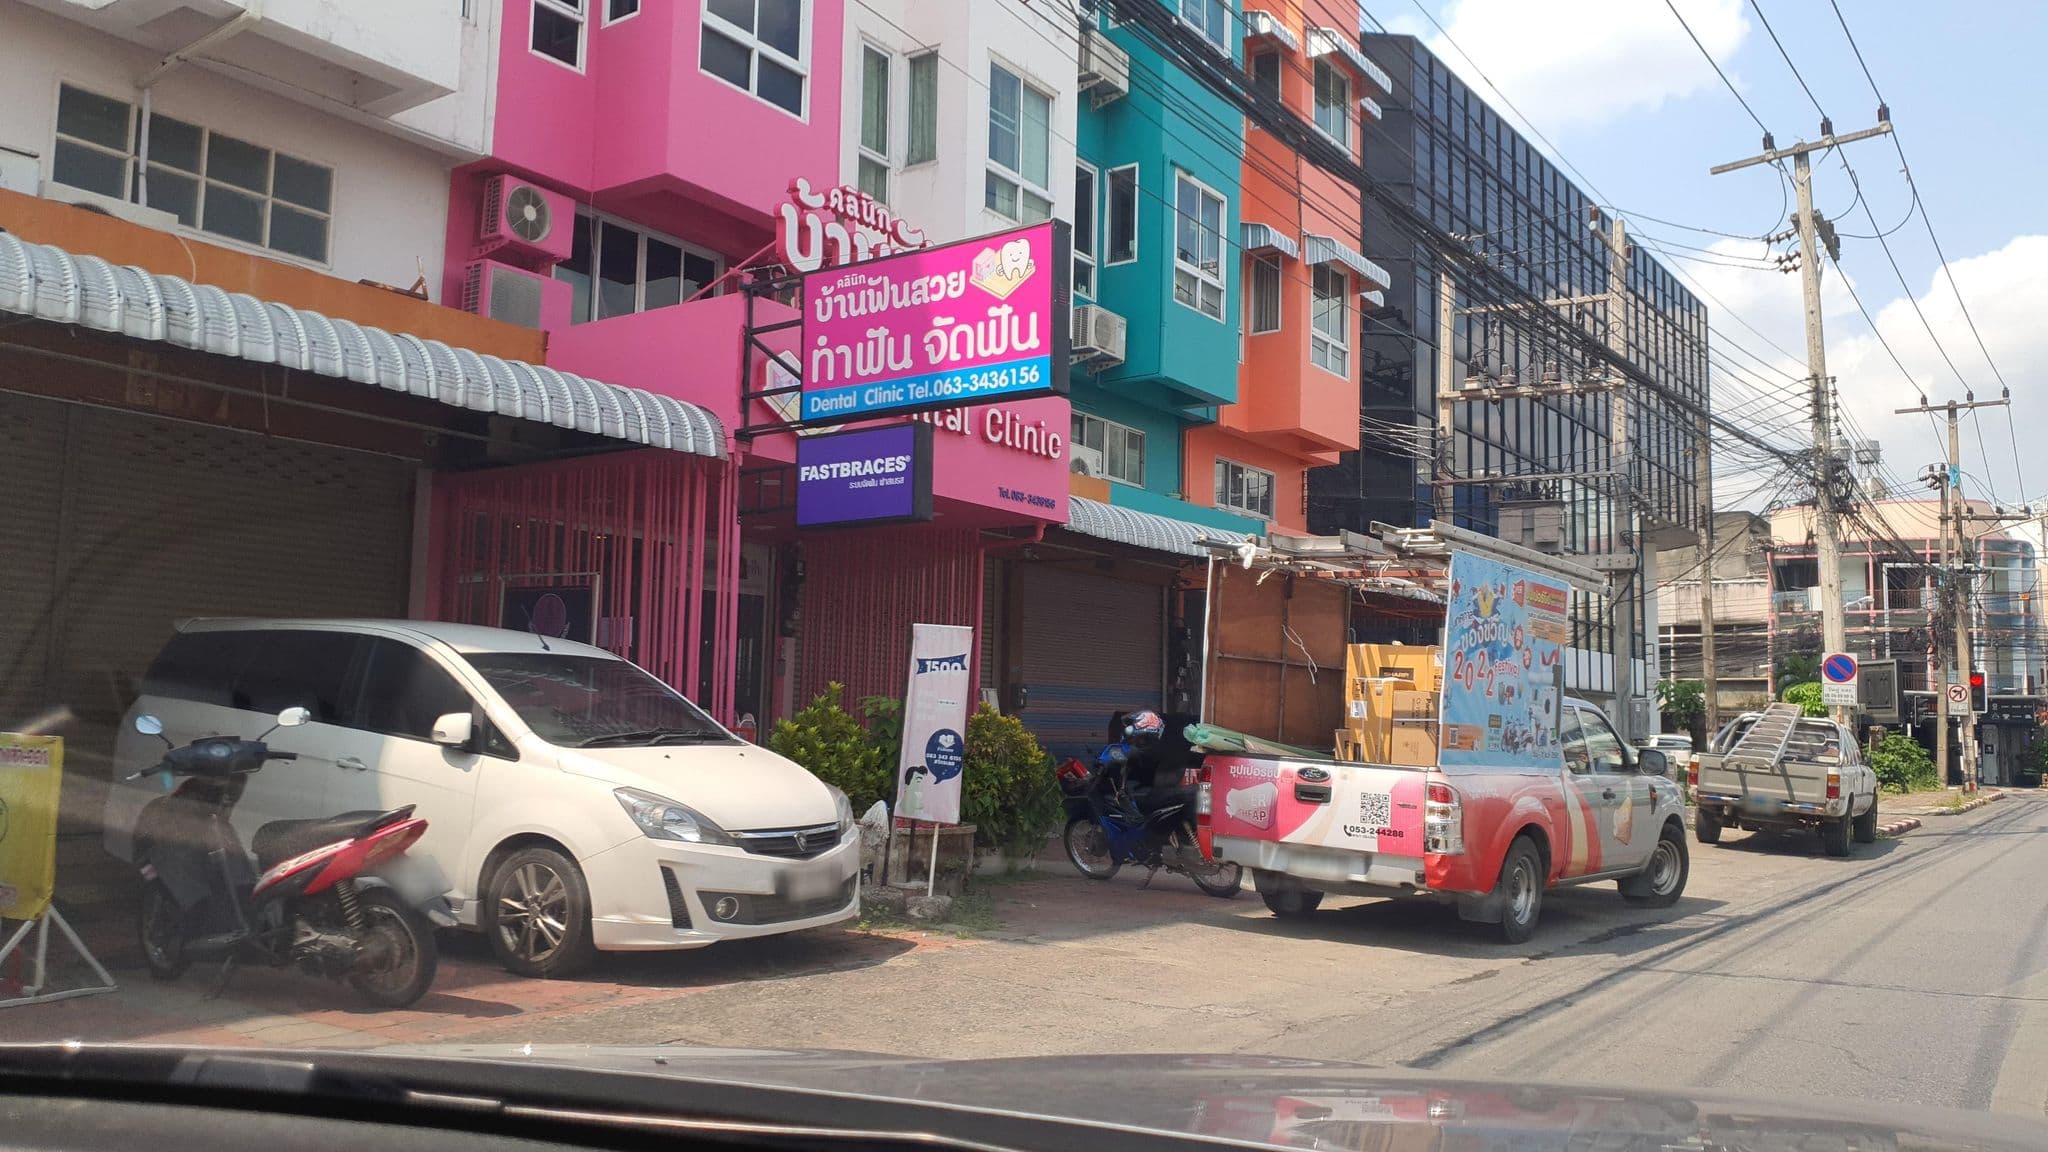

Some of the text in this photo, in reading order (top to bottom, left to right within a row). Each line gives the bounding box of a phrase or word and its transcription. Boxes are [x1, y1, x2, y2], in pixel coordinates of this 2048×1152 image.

[830, 186, 892, 232] คลินิก
[814, 270, 966, 323] บ้านฟันสวย
[837, 273, 867, 289] คลินิก
[811, 304, 1040, 384] ทำฟัน จัดฟัน
[810, 391, 857, 413] Dental
[864, 384, 904, 406] Clinic
[985, 408, 1062, 460] Clinic
[925, 660, 962, 673] 1500
[1453, 650, 1495, 697] 2022
[1349, 825, 1404, 838] 053-244288
